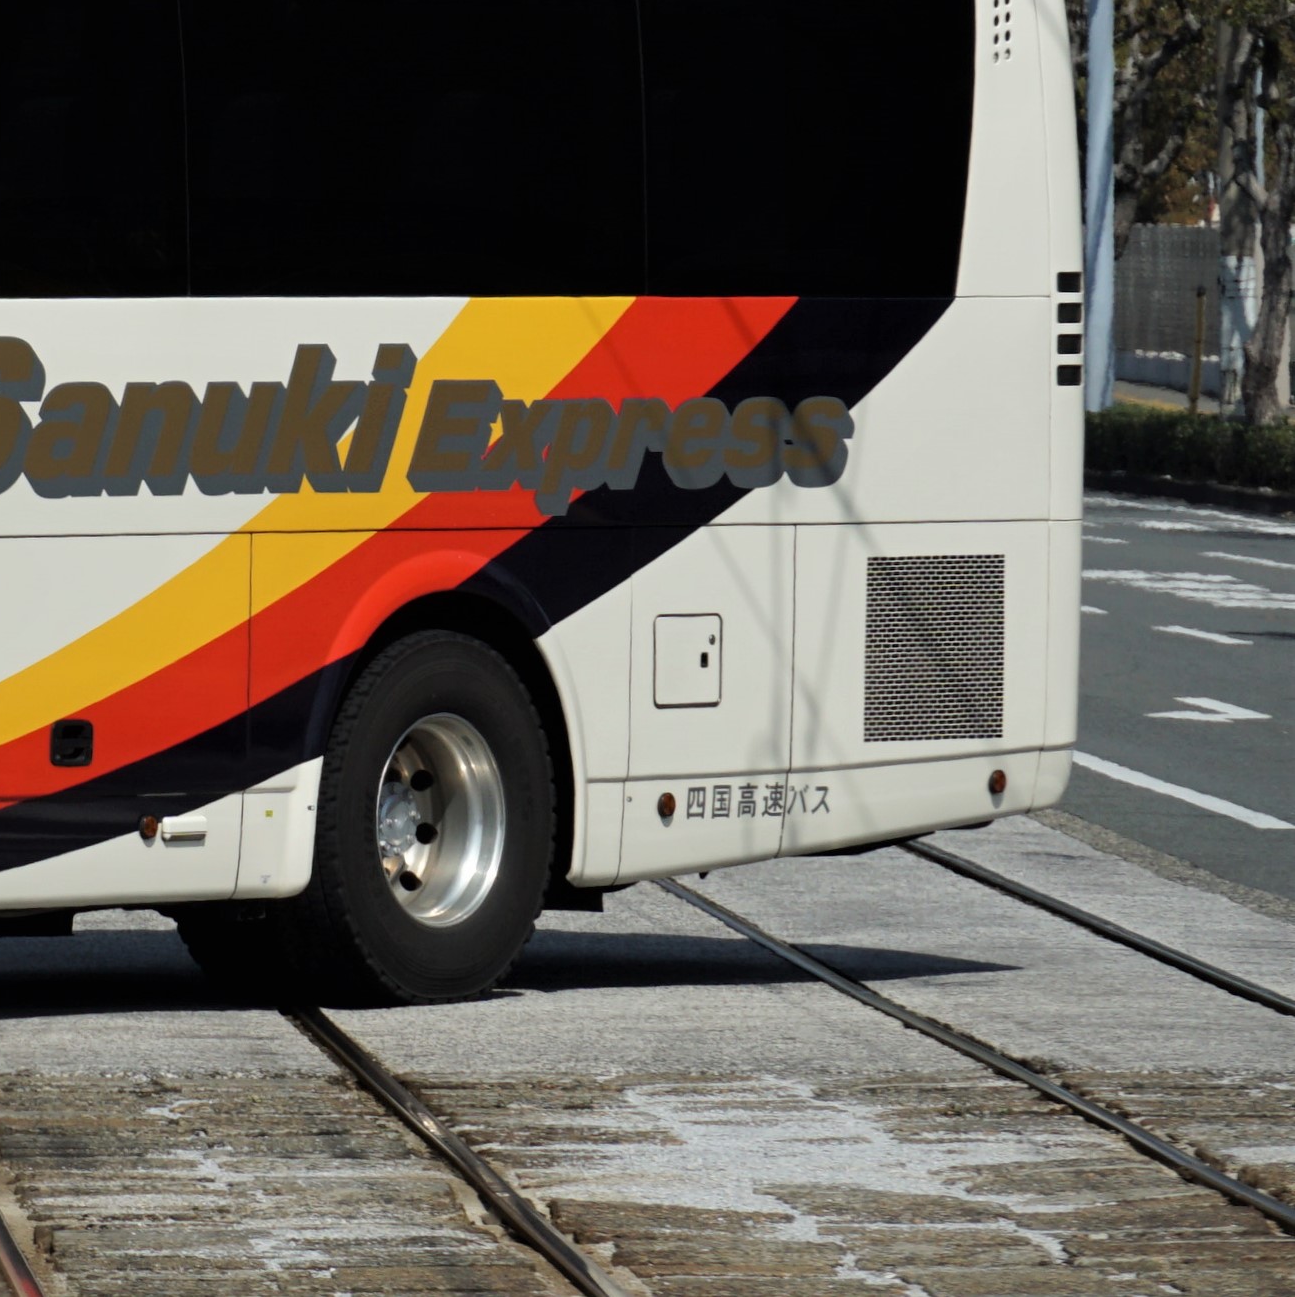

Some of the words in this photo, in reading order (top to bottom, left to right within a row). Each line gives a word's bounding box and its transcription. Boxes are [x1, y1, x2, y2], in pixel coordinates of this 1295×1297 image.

[406, 378, 856, 516] Express
[685, 782, 832, 820] 四国高速バス
